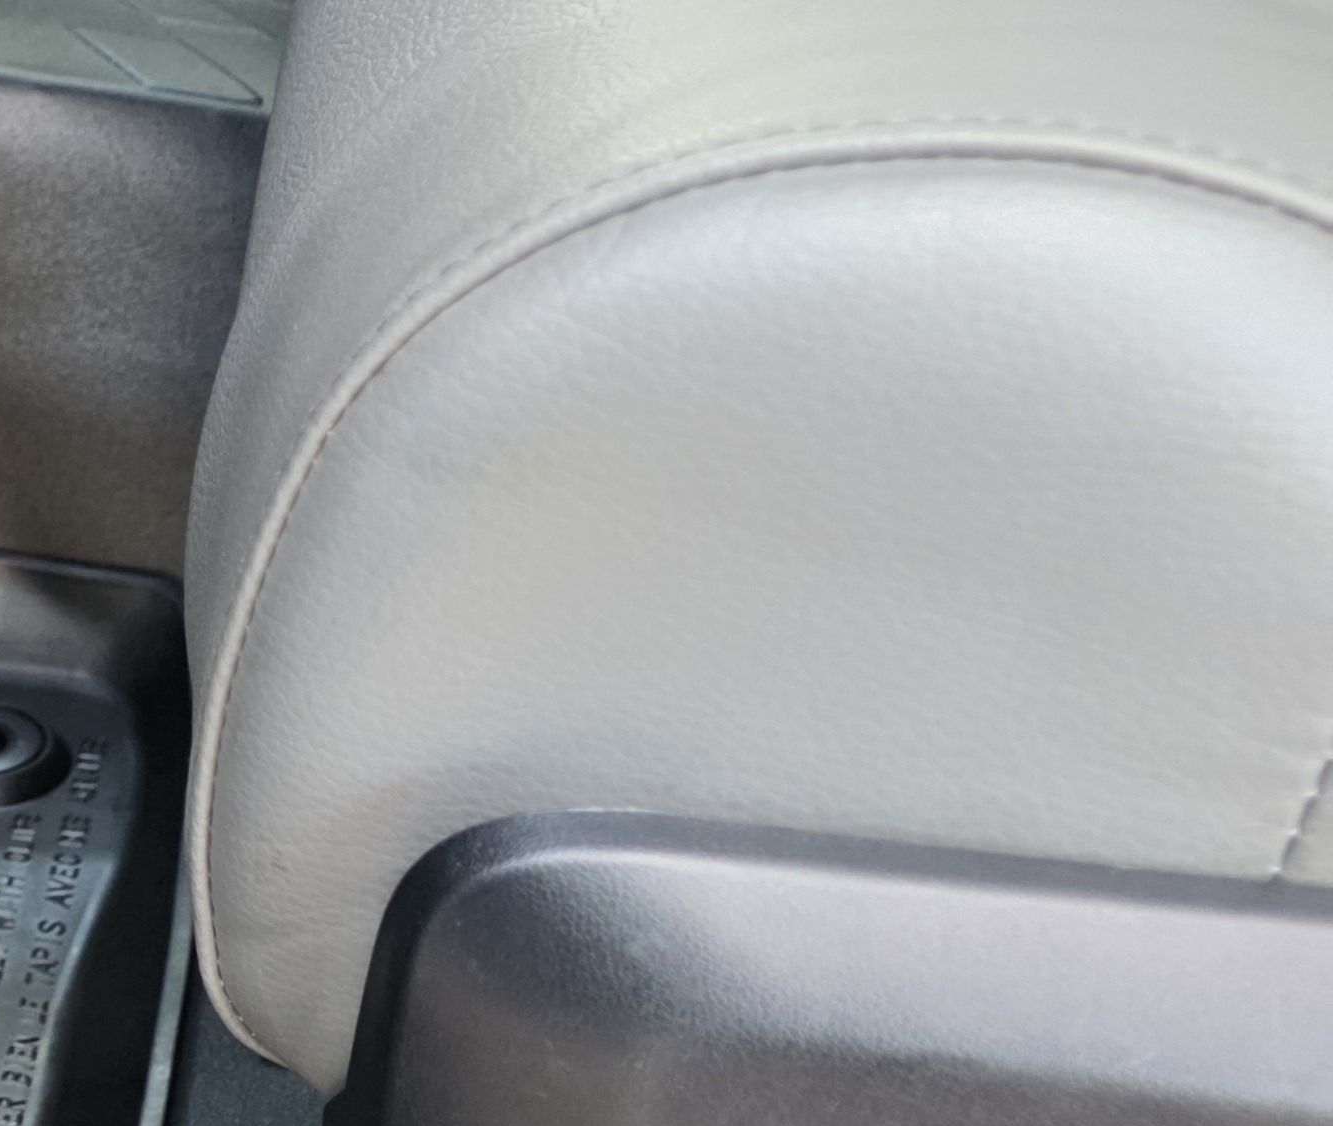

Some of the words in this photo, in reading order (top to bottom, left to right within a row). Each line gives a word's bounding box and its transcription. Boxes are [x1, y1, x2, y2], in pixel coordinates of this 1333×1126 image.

[44, 851, 83, 909] AVEC
[23, 918, 67, 987] TAPIS
[16, 995, 50, 1027] LE
[0, 1036, 40, 1088] BIEN
